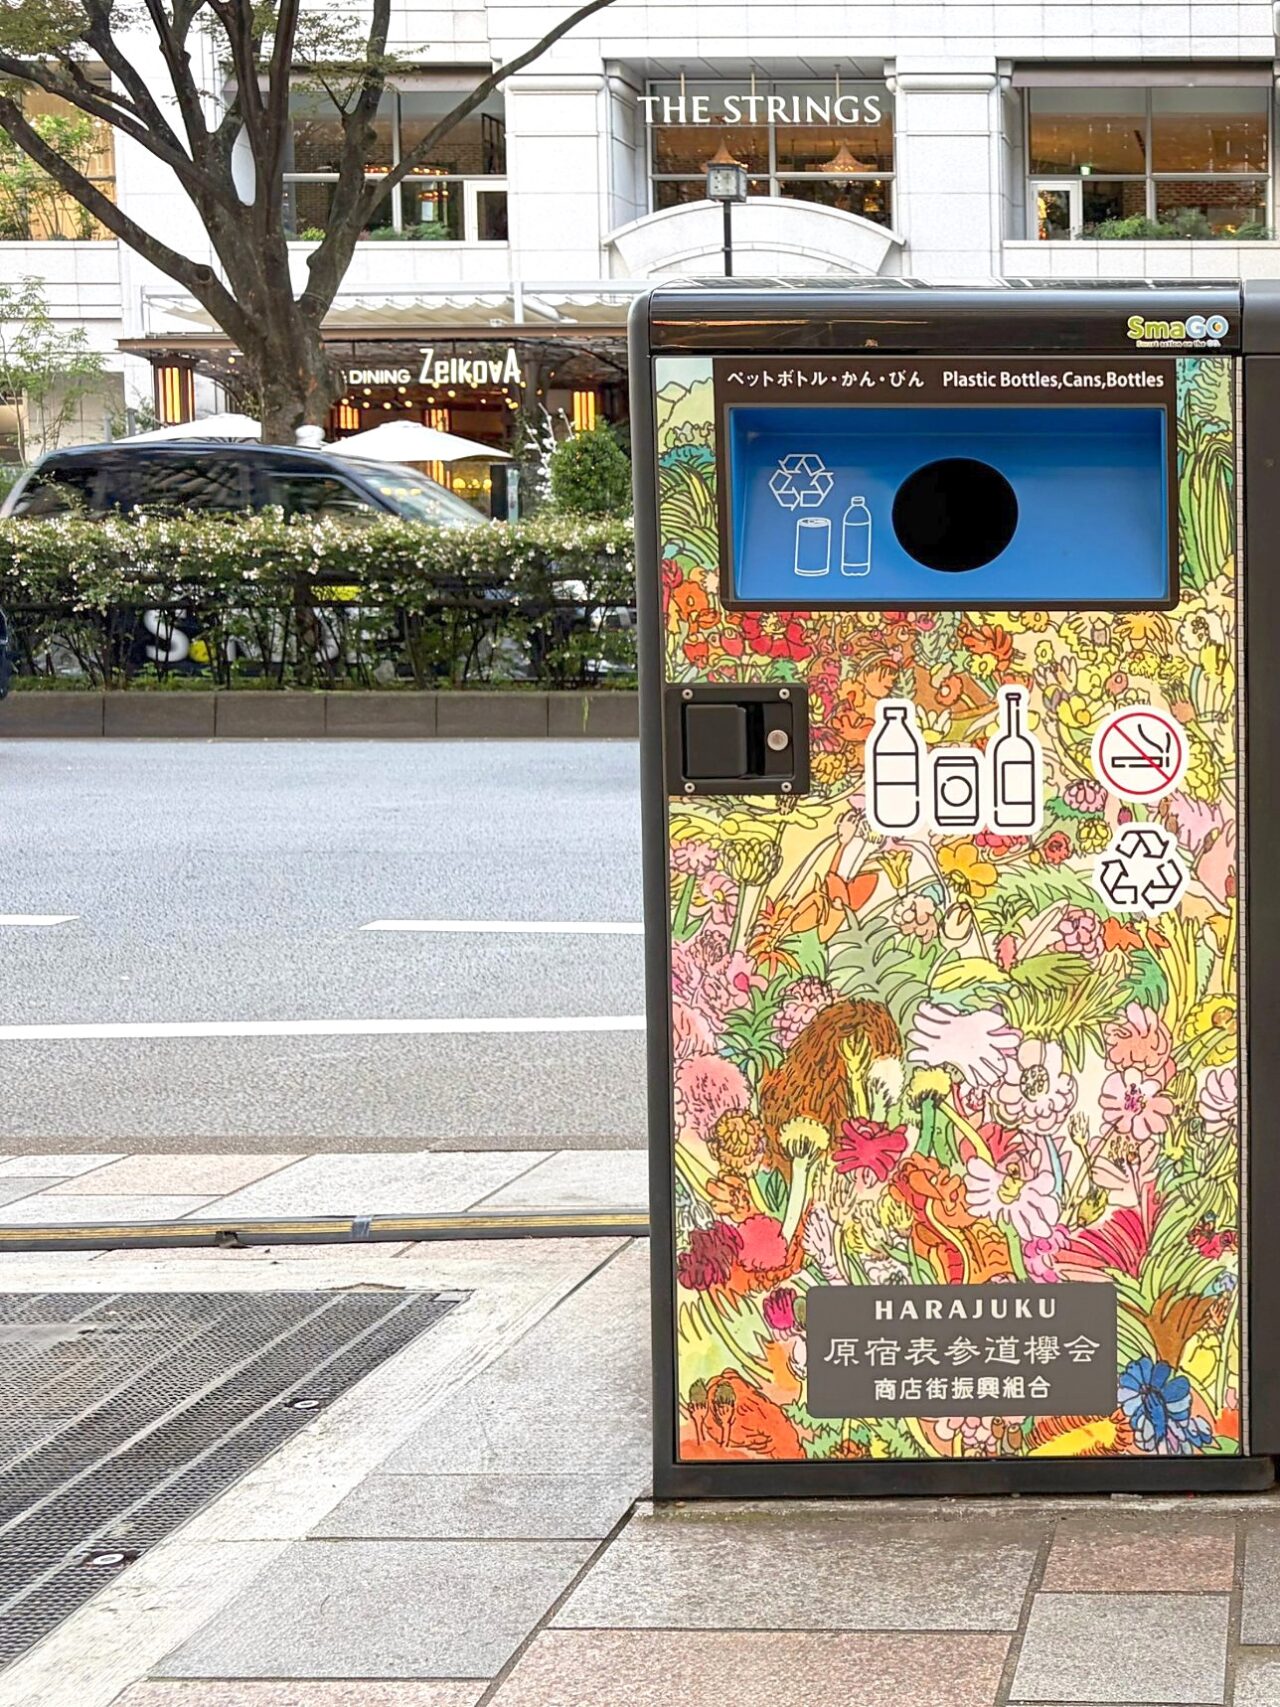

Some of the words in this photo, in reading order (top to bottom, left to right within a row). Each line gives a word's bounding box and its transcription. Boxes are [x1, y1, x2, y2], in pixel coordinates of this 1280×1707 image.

[637, 96, 710, 123] THE
[724, 95, 882, 124] STRINGS
[1127, 315, 1229, 339] SmaGO
[349, 369, 411, 385] DINING
[727, 369, 924, 388] ペットボトル・かん・びん
[943, 371, 996, 388] Plastic
[1000, 370, 1164, 390] Bottles,Cans,Bottles
[875, 1298, 1057, 1320] HARAJUKU
[824, 1335, 1101, 1367] 原宿表参道欅会
[874, 1376, 1051, 1400] 商店街振興組合
